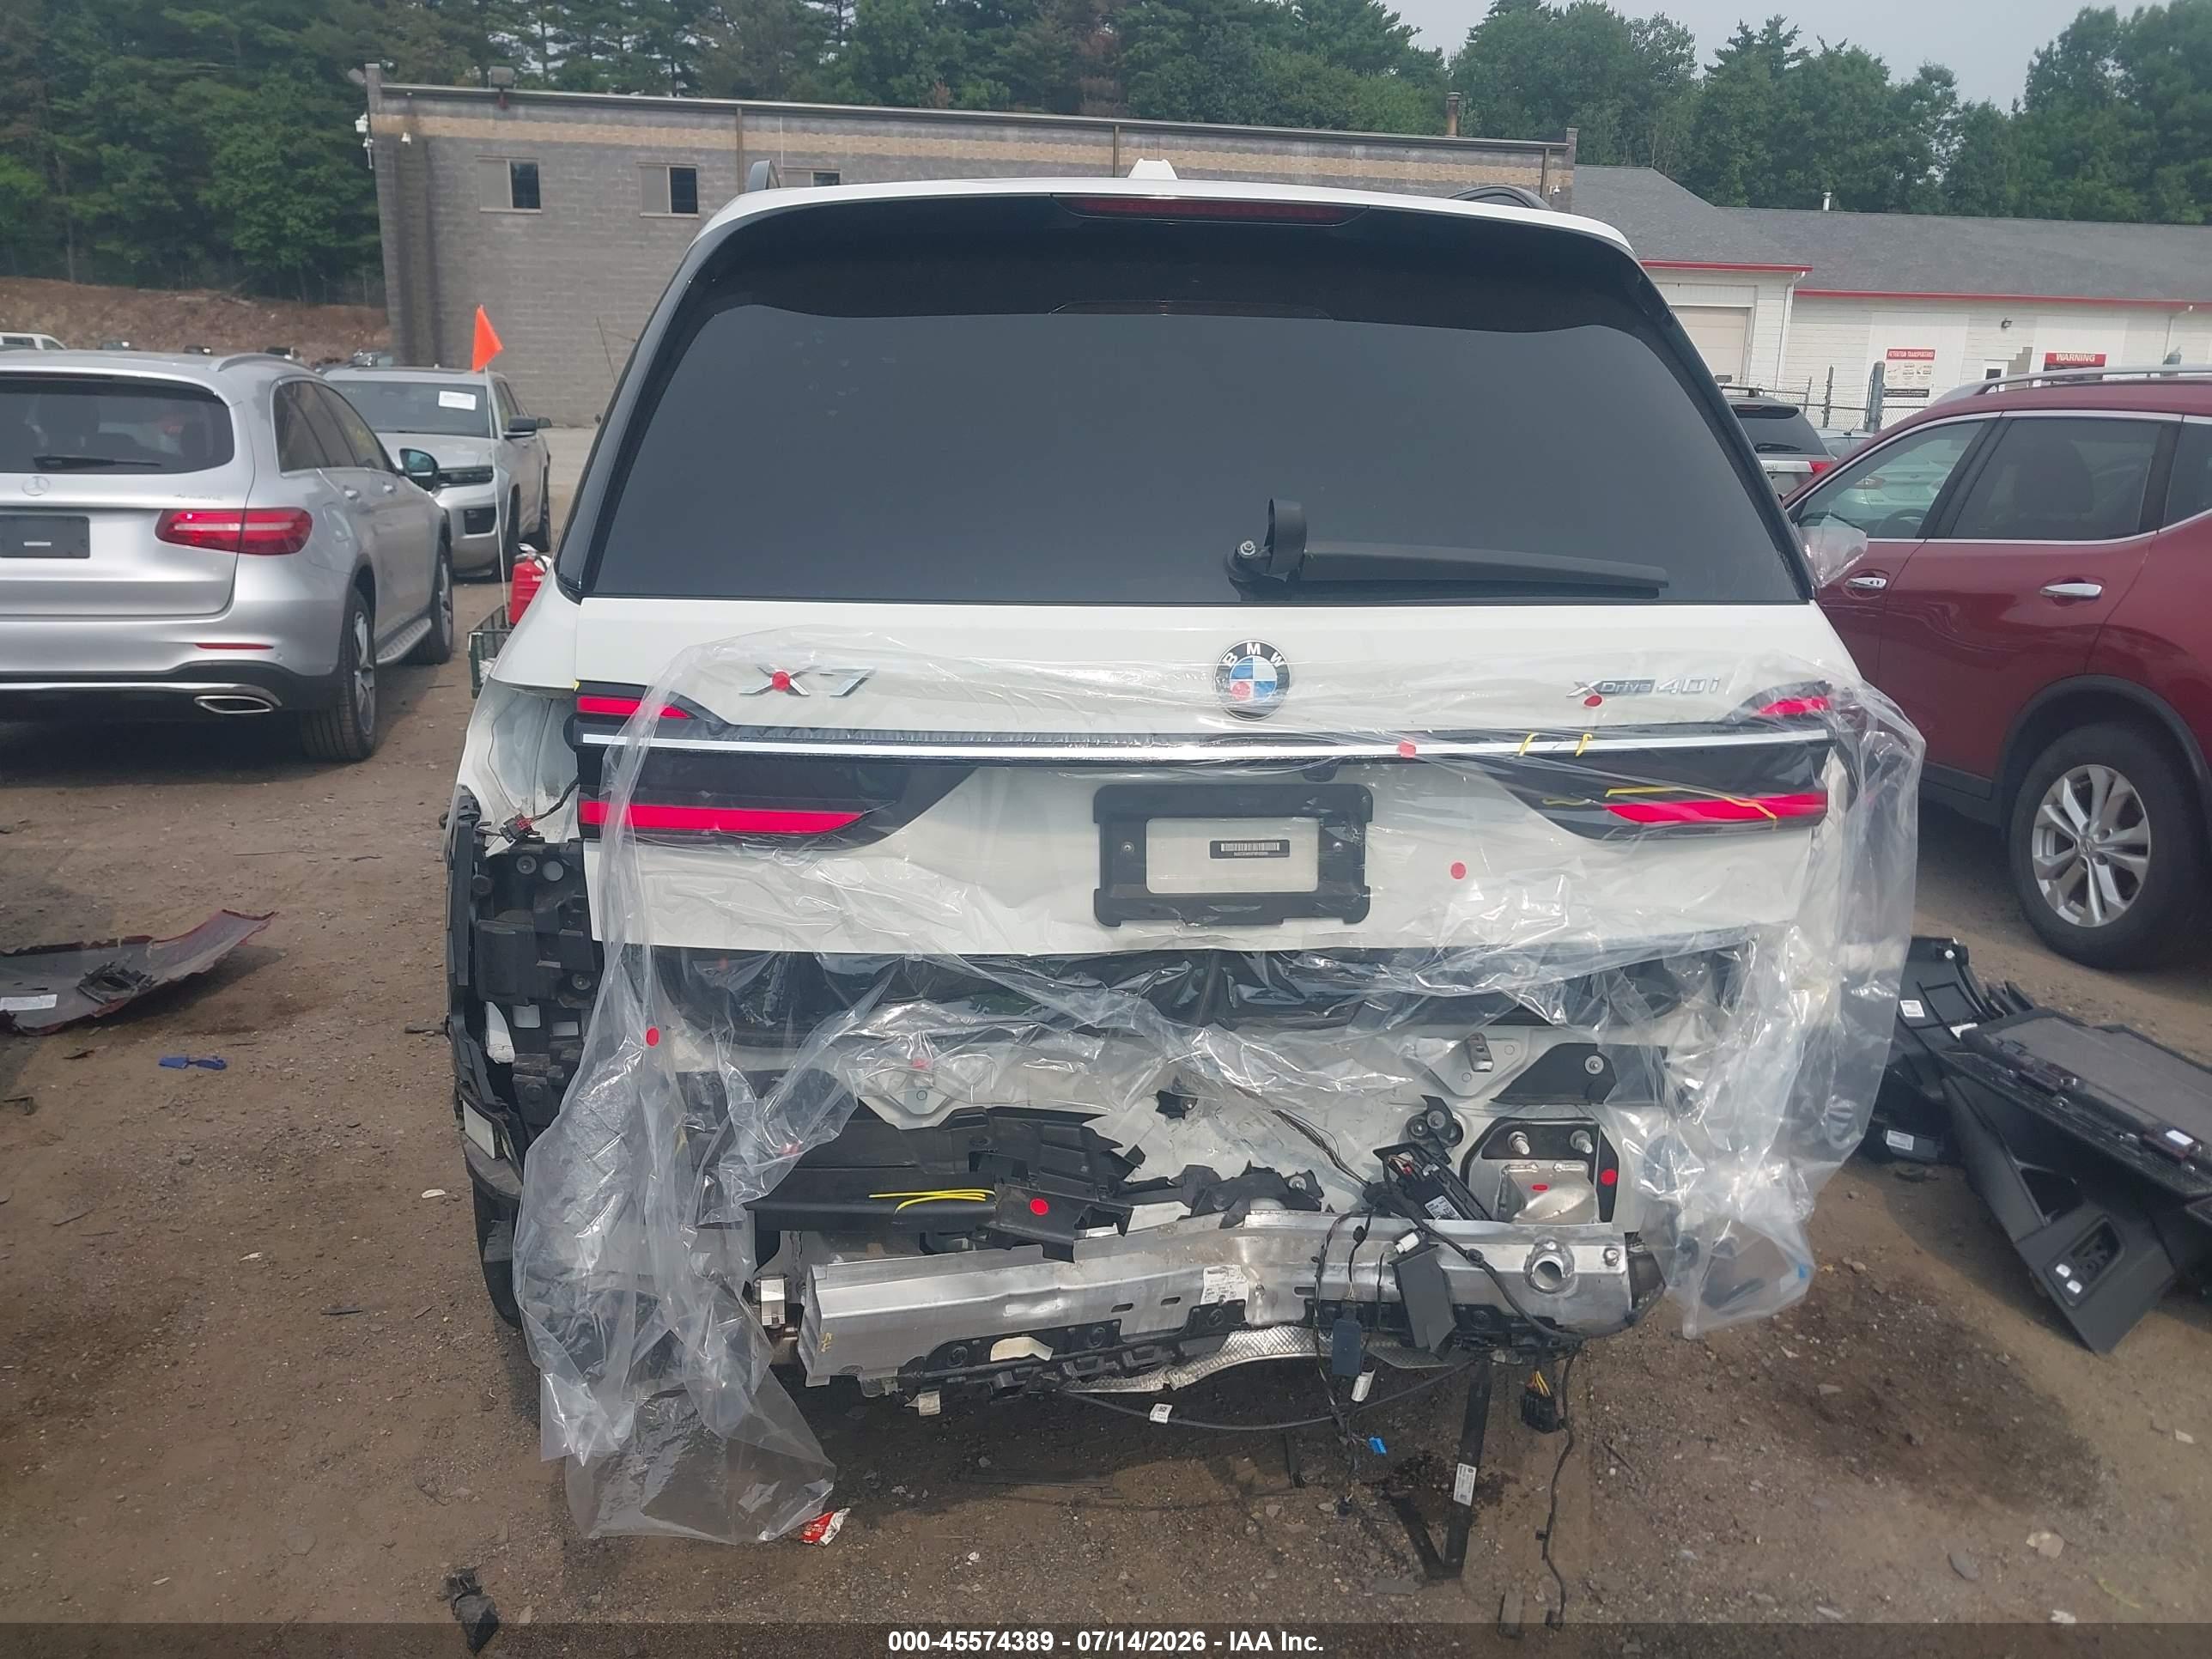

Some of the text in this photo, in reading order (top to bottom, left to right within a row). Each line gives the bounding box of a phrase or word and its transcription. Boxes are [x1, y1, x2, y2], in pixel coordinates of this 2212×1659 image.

[2056, 353, 2096, 362] WARNING
[1222, 642, 1286, 668] BMW
[738, 664, 877, 697] X7
